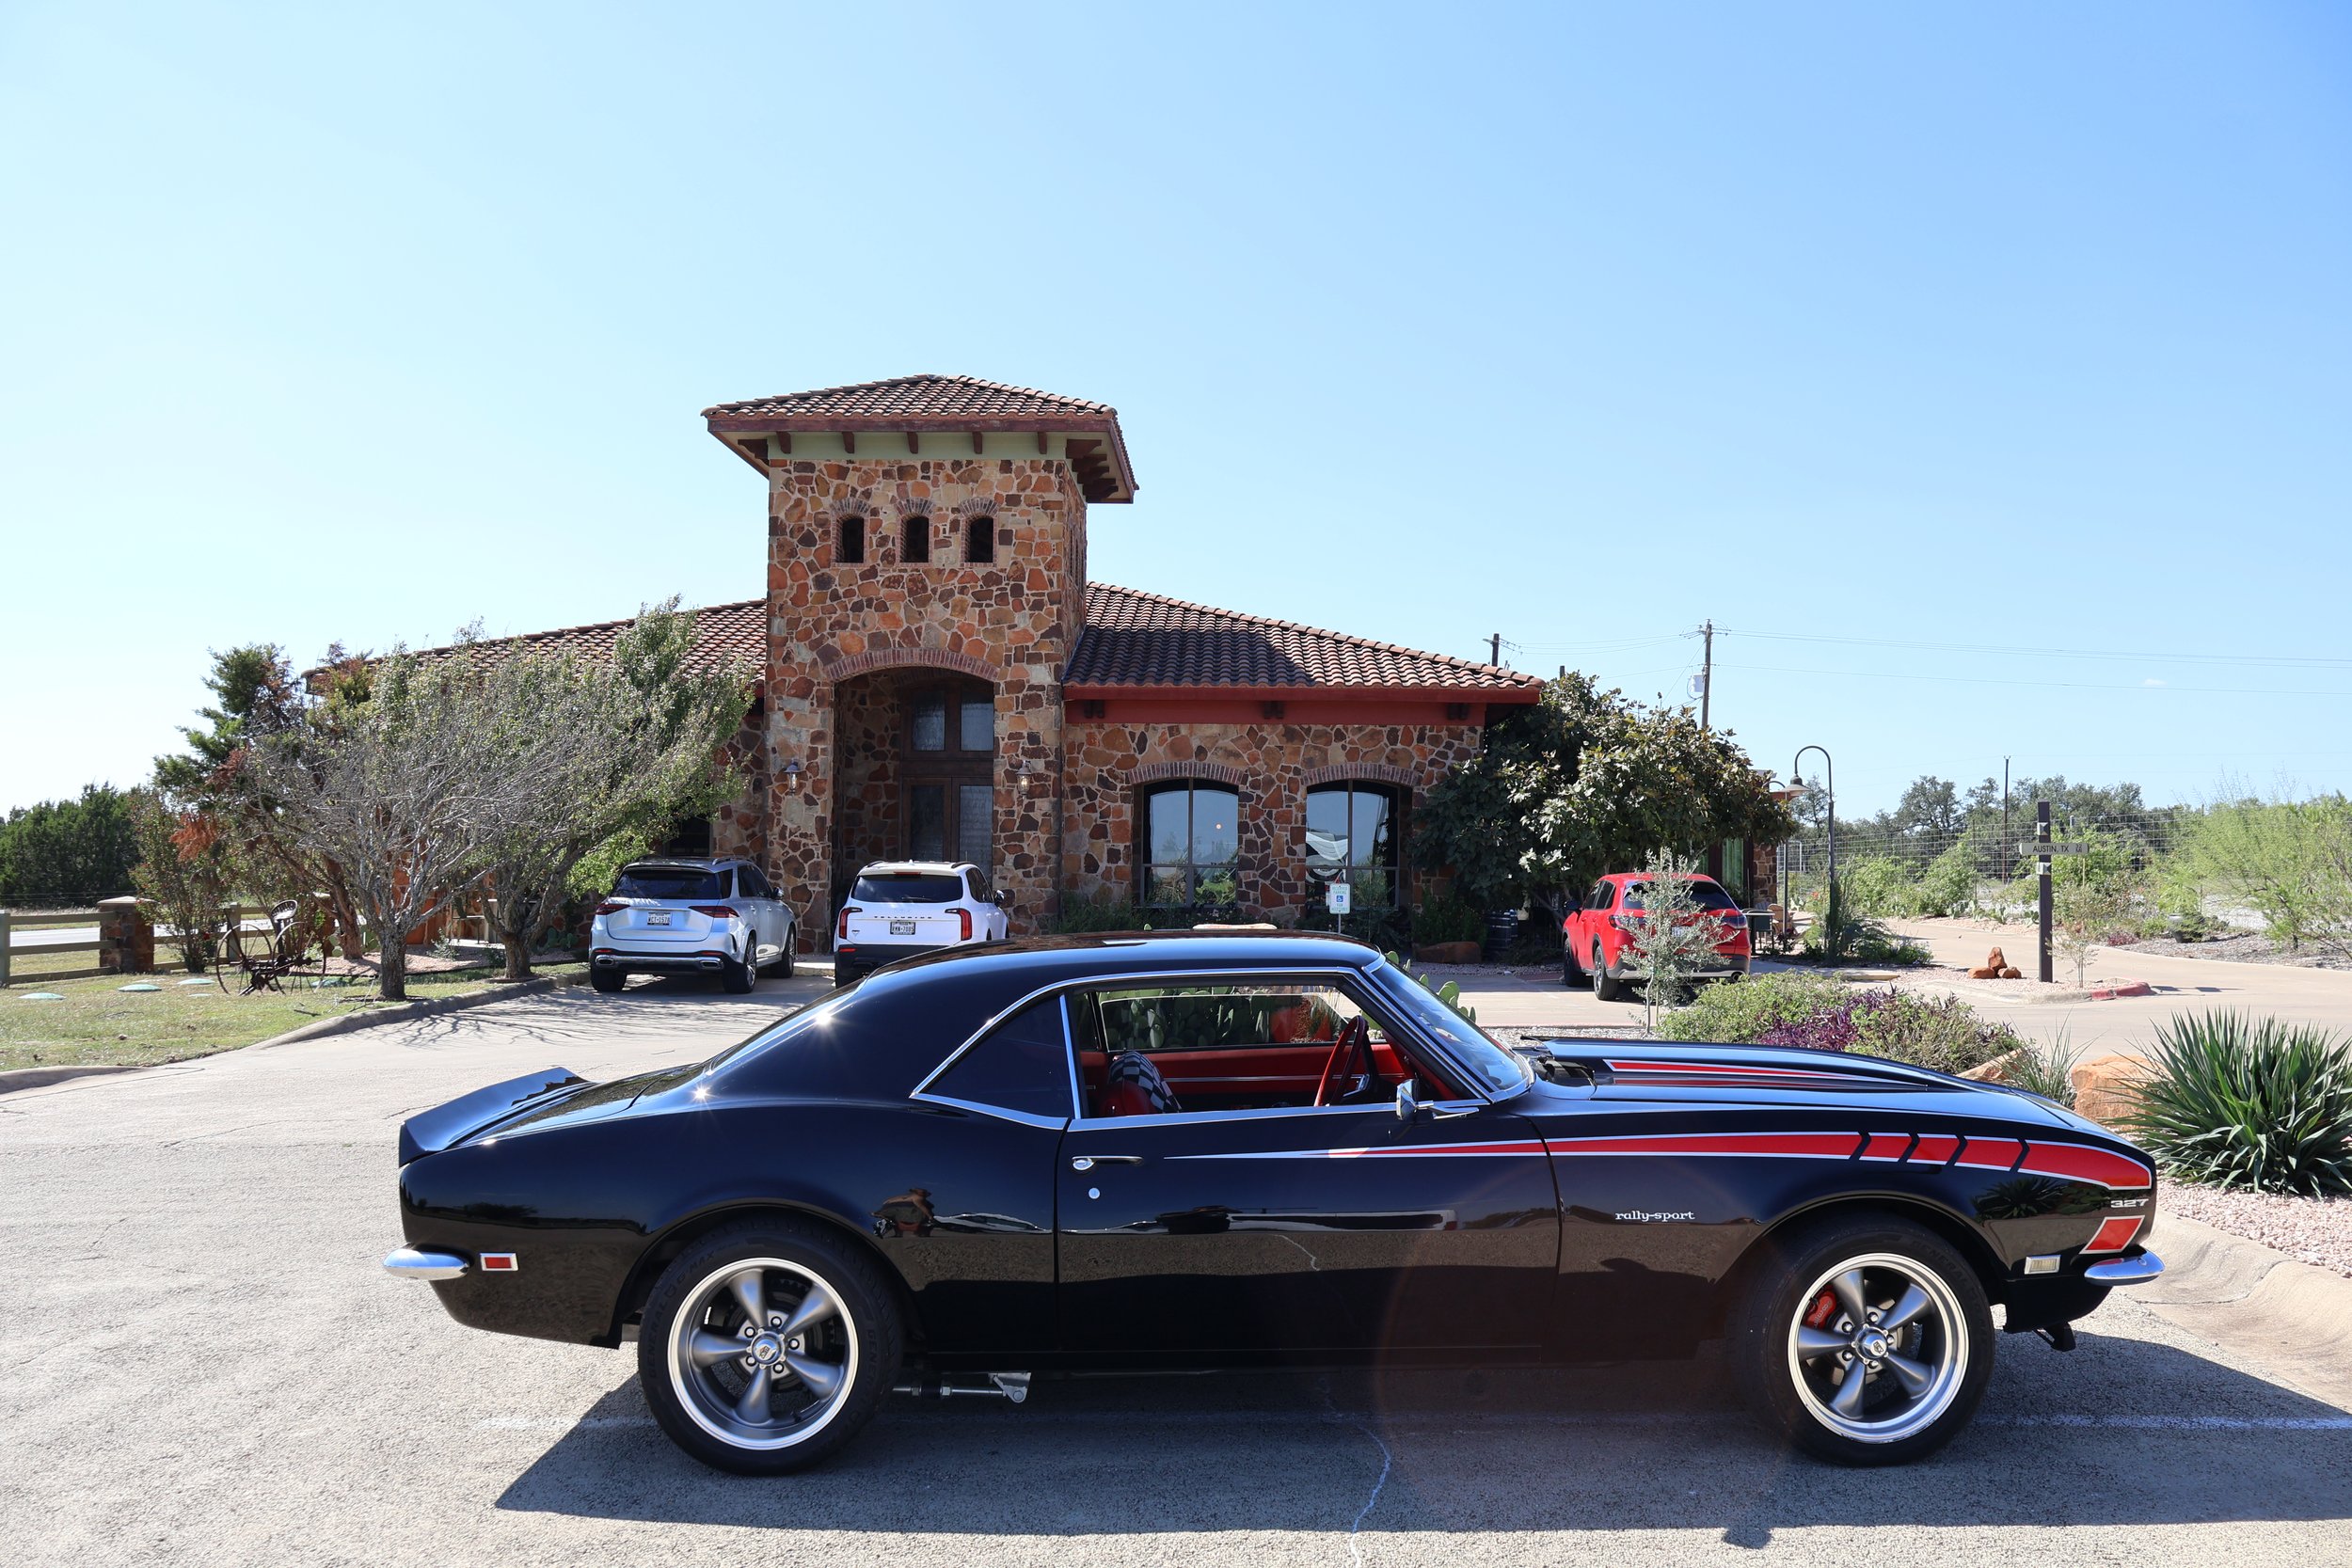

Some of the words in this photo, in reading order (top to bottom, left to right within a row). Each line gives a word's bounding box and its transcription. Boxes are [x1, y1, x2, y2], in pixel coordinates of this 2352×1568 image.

[2032, 845, 2058, 853] AUSTIN,
[2110, 1198, 2150, 1208] 327
[1615, 1211, 1695, 1222] rally-sport
